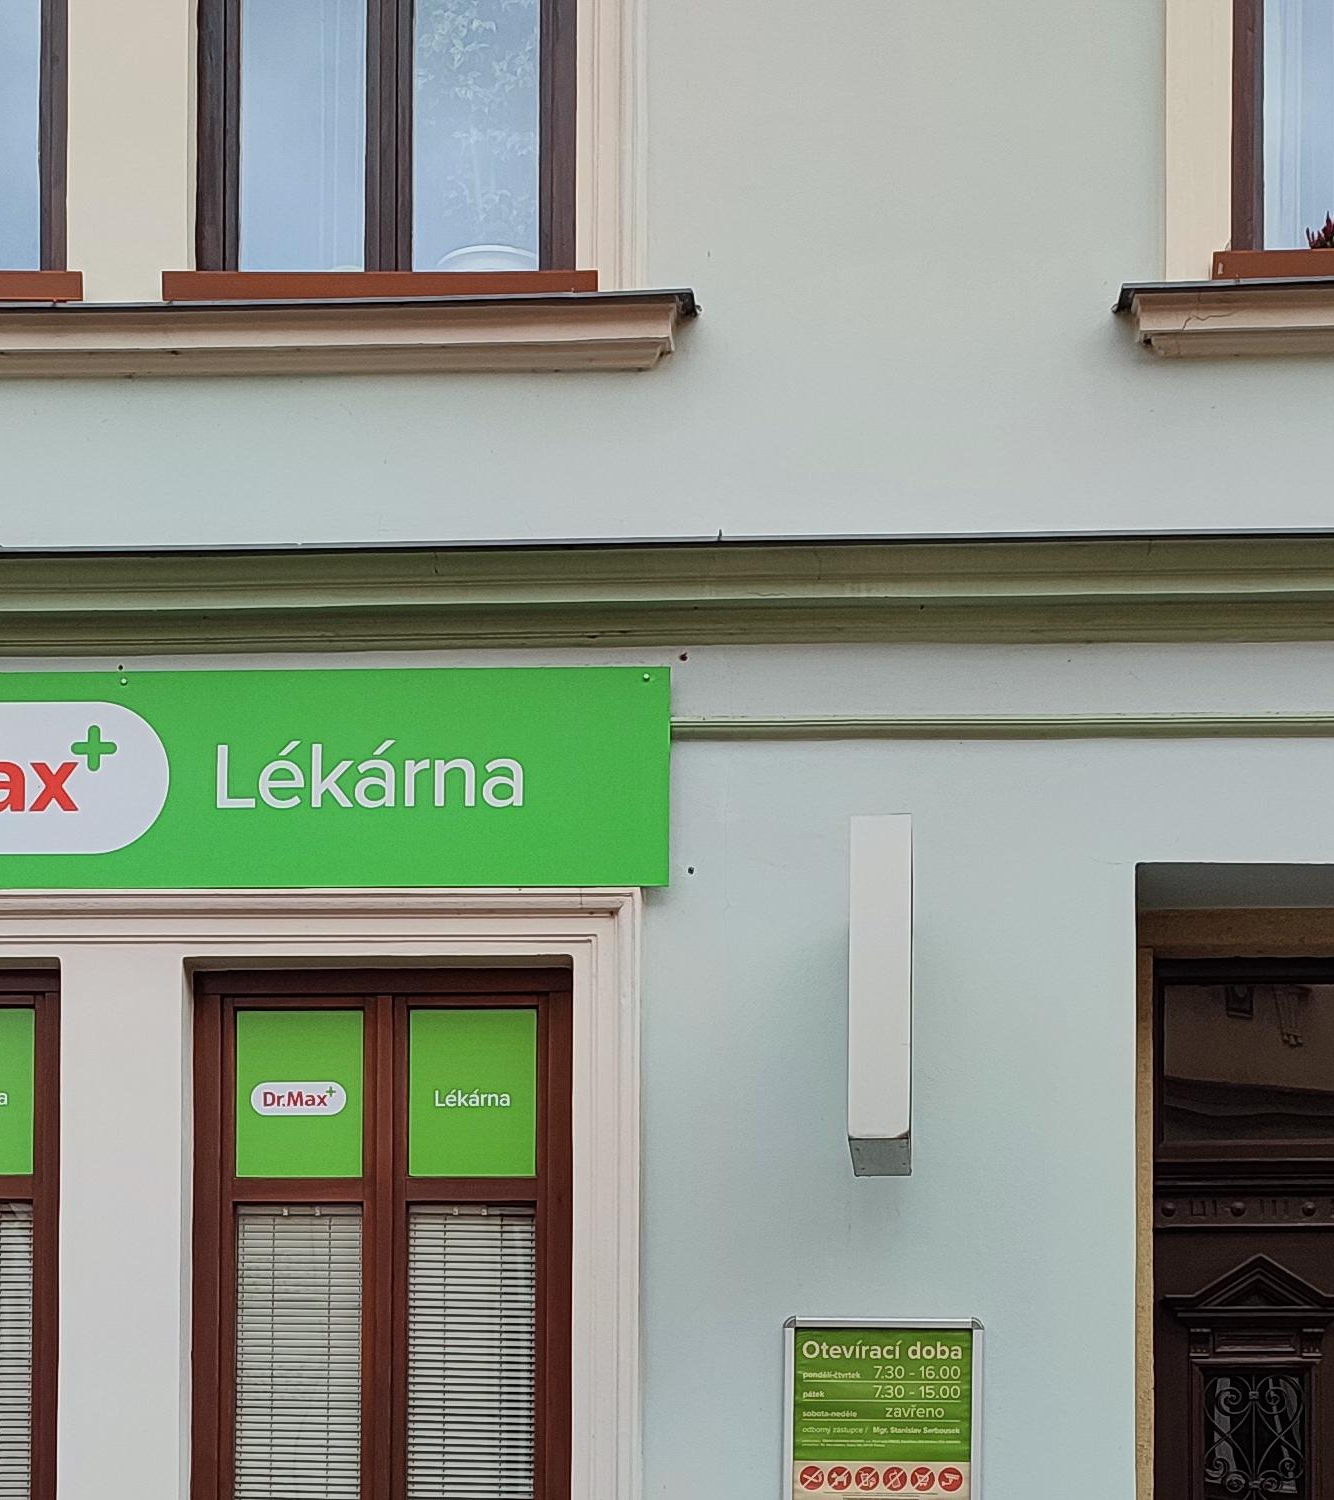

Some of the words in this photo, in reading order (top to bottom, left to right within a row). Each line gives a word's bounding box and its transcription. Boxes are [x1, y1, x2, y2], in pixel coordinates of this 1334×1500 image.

[214, 738, 525, 810] Lékárna
[434, 1089, 511, 1107] Lékárna
[802, 1340, 902, 1360] Otevírací
[907, 1341, 962, 1360] doba
[873, 1366, 905, 1379] 7.30
[919, 1366, 961, 1379] 16.00
[873, 1385, 905, 1399] 7.30
[919, 1385, 961, 1399] 15.00
[885, 1404, 945, 1418] zavřeno
